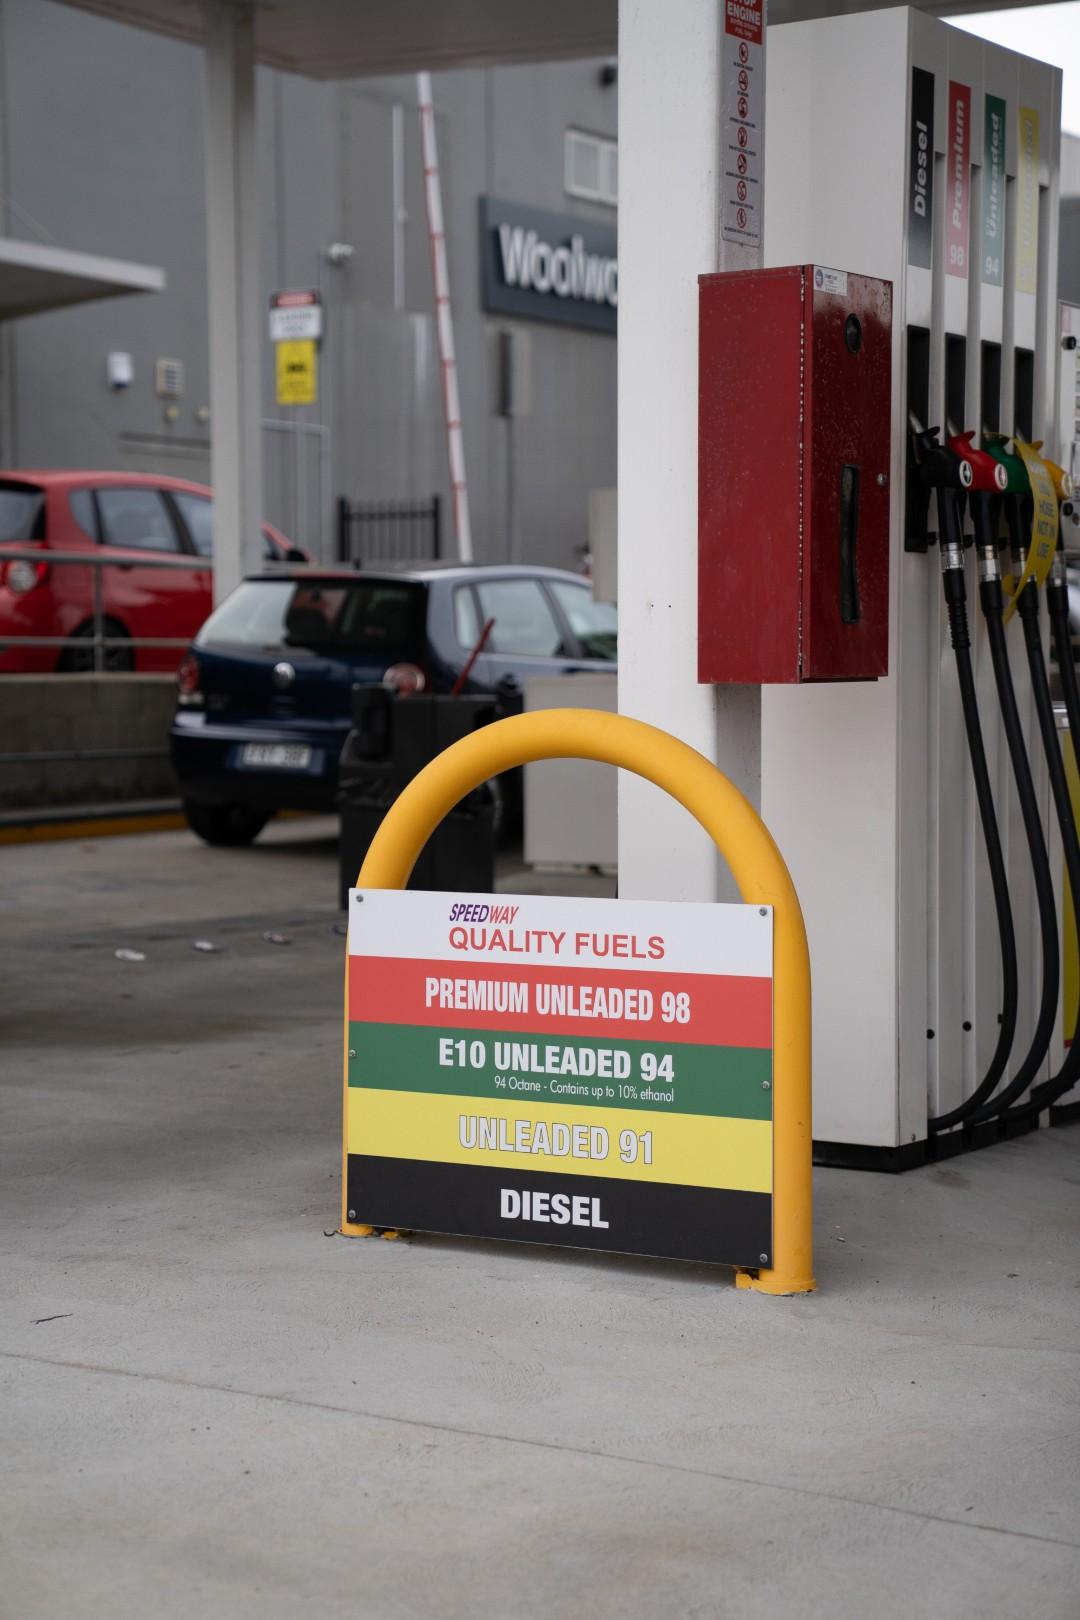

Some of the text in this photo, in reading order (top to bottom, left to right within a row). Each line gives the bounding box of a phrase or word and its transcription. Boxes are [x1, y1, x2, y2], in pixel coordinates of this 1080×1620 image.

[727, 1, 762, 26] ENGINE
[914, 120, 928, 218] Diesel
[952, 99, 965, 230] Premium
[987, 113, 1000, 238] Unleaded
[949, 244, 964, 266] 98
[985, 256, 1000, 277] 94
[449, 903, 519, 924] SPEEDWAY
[449, 926, 665, 959] QUALITY FUELS
[425, 977, 690, 1024] PREMIUM UNLEADED 98
[439, 1037, 675, 1083] E10 UNLEADED 94
[494, 1076, 507, 1089] 94
[508, 1076, 541, 1093] Octane
[549, 1080, 589, 1097] Contains
[591, 1087, 603, 1101] up
[605, 1085, 615, 1098] to
[618, 1084, 638, 1100] 10%
[640, 1087, 674, 1103] ethanol
[458, 1114, 653, 1165] UNLEADED 91
[500, 1188, 610, 1229] DIESEL
